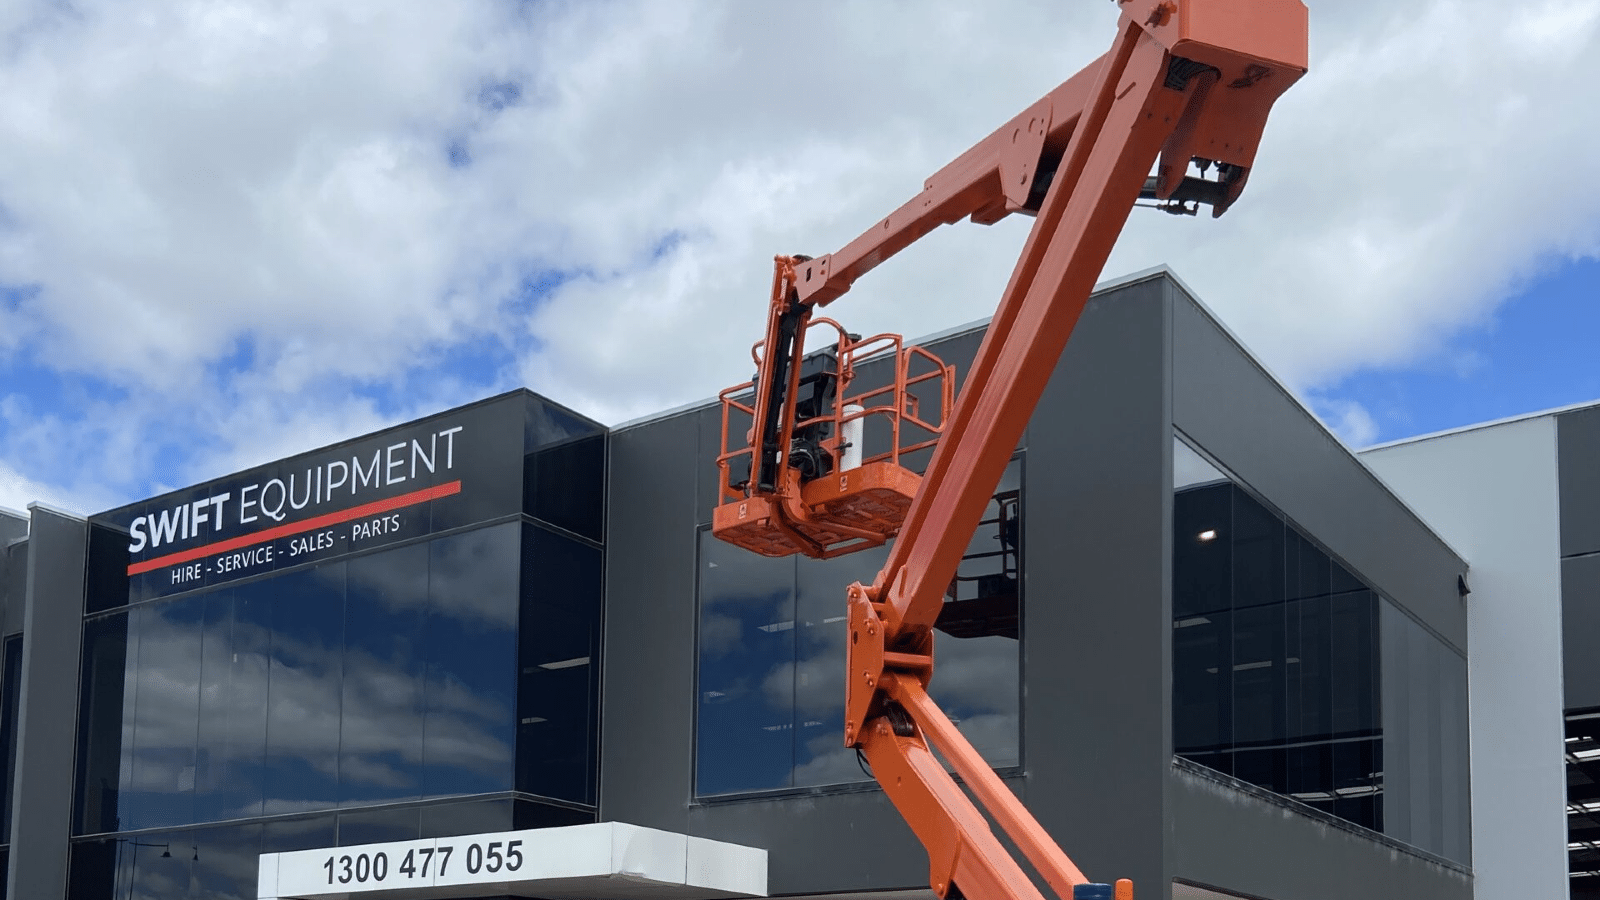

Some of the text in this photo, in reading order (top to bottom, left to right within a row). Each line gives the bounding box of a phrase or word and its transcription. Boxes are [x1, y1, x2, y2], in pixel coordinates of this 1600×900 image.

[128, 426, 463, 553] SWIFT EQUIPMENT
[172, 563, 201, 584] HIRE
[217, 546, 273, 574] SERVICE
[290, 530, 334, 556] SALES
[352, 514, 400, 542] PARTS
[323, 840, 523, 885] 1300 477 055
